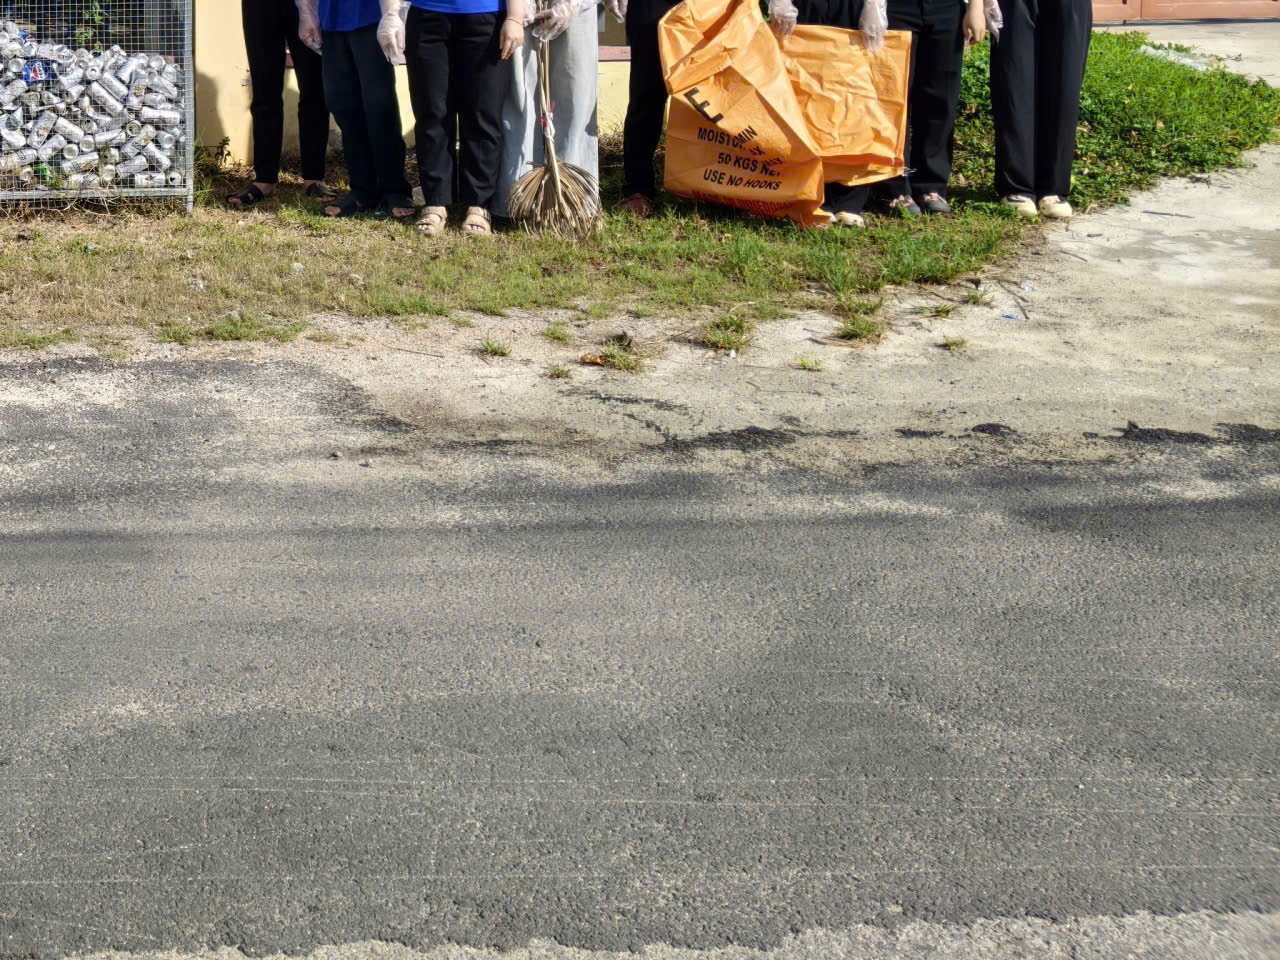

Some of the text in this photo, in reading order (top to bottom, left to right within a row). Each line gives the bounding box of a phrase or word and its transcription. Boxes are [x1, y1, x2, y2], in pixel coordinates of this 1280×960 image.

[717, 152, 732, 165] 50
[733, 156, 758, 172] KGS
[703, 168, 782, 191] USE NO HOOKS
